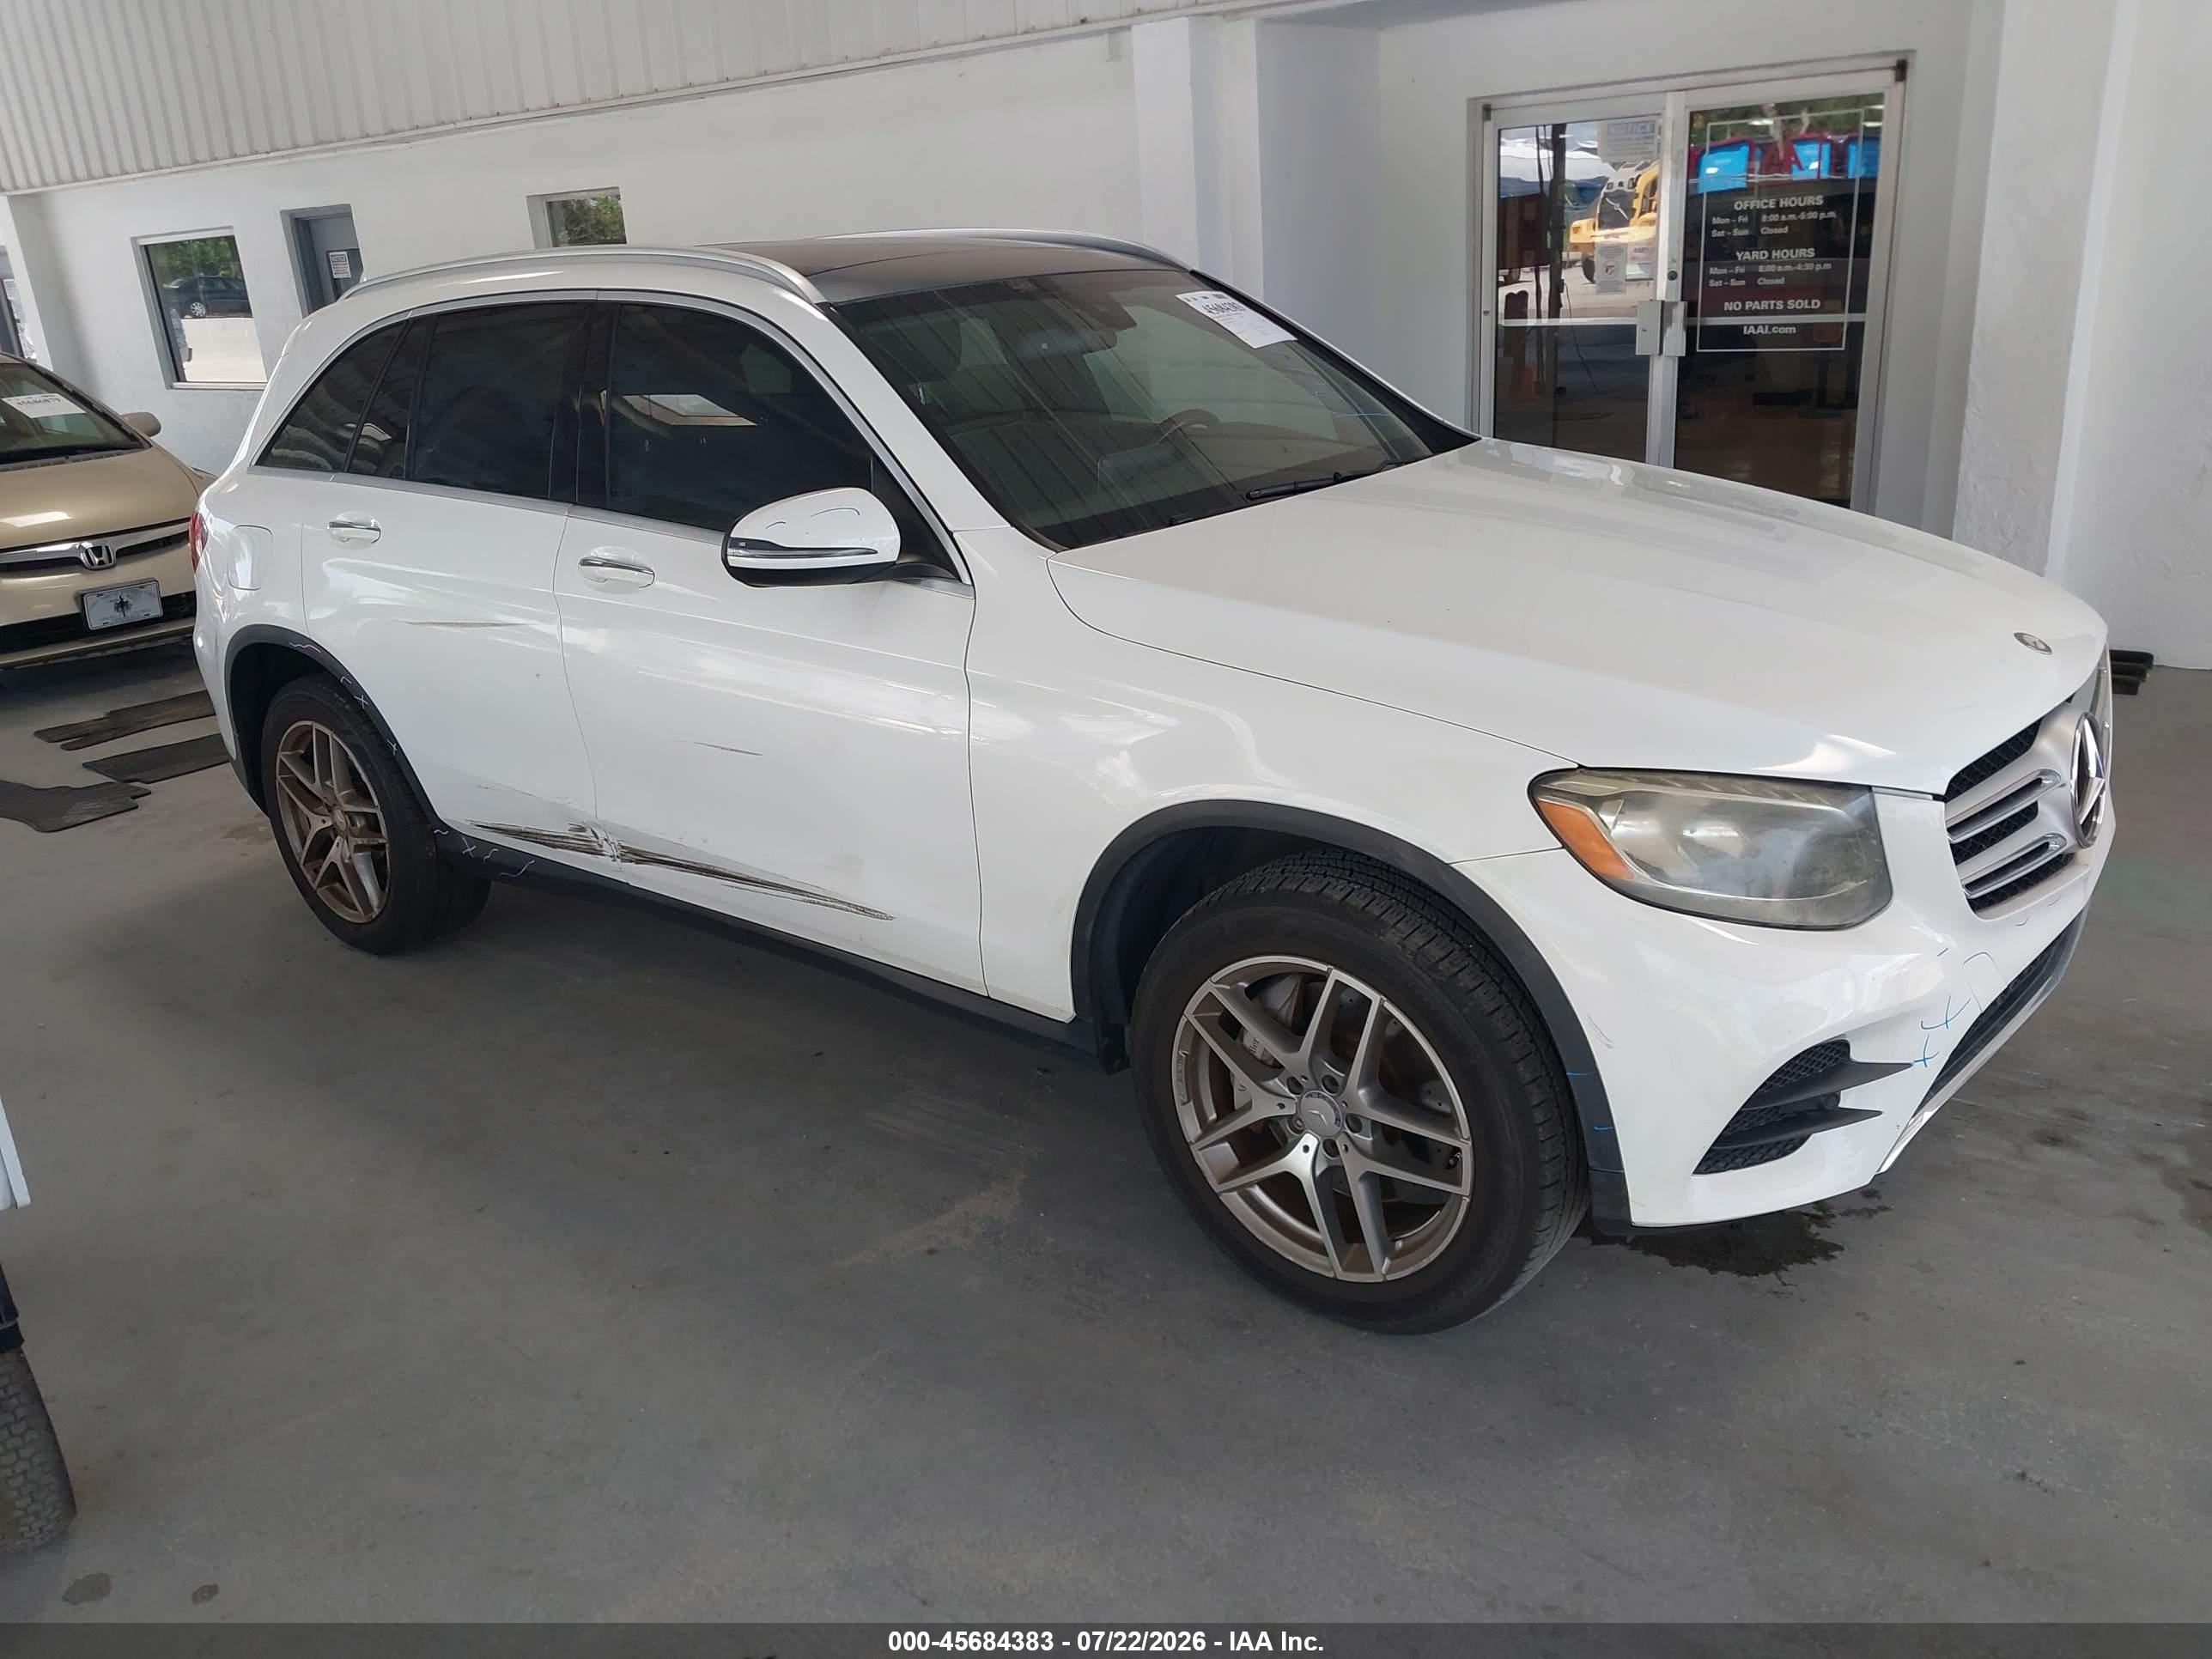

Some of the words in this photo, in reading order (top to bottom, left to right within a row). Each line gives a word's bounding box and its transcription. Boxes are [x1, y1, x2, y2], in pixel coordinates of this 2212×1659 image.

[1734, 199, 1776, 210] OFFICE
[1779, 195, 1824, 208] HOURS
[1760, 226, 1789, 234] Closed
[1736, 250, 1769, 260] YARD
[1771, 248, 1815, 259] HOURS
[1724, 301, 1742, 311] NO
[1745, 301, 1784, 310] PARTS
[1787, 299, 1821, 309] SOLD
[1743, 325, 1796, 335] IAAI.com
